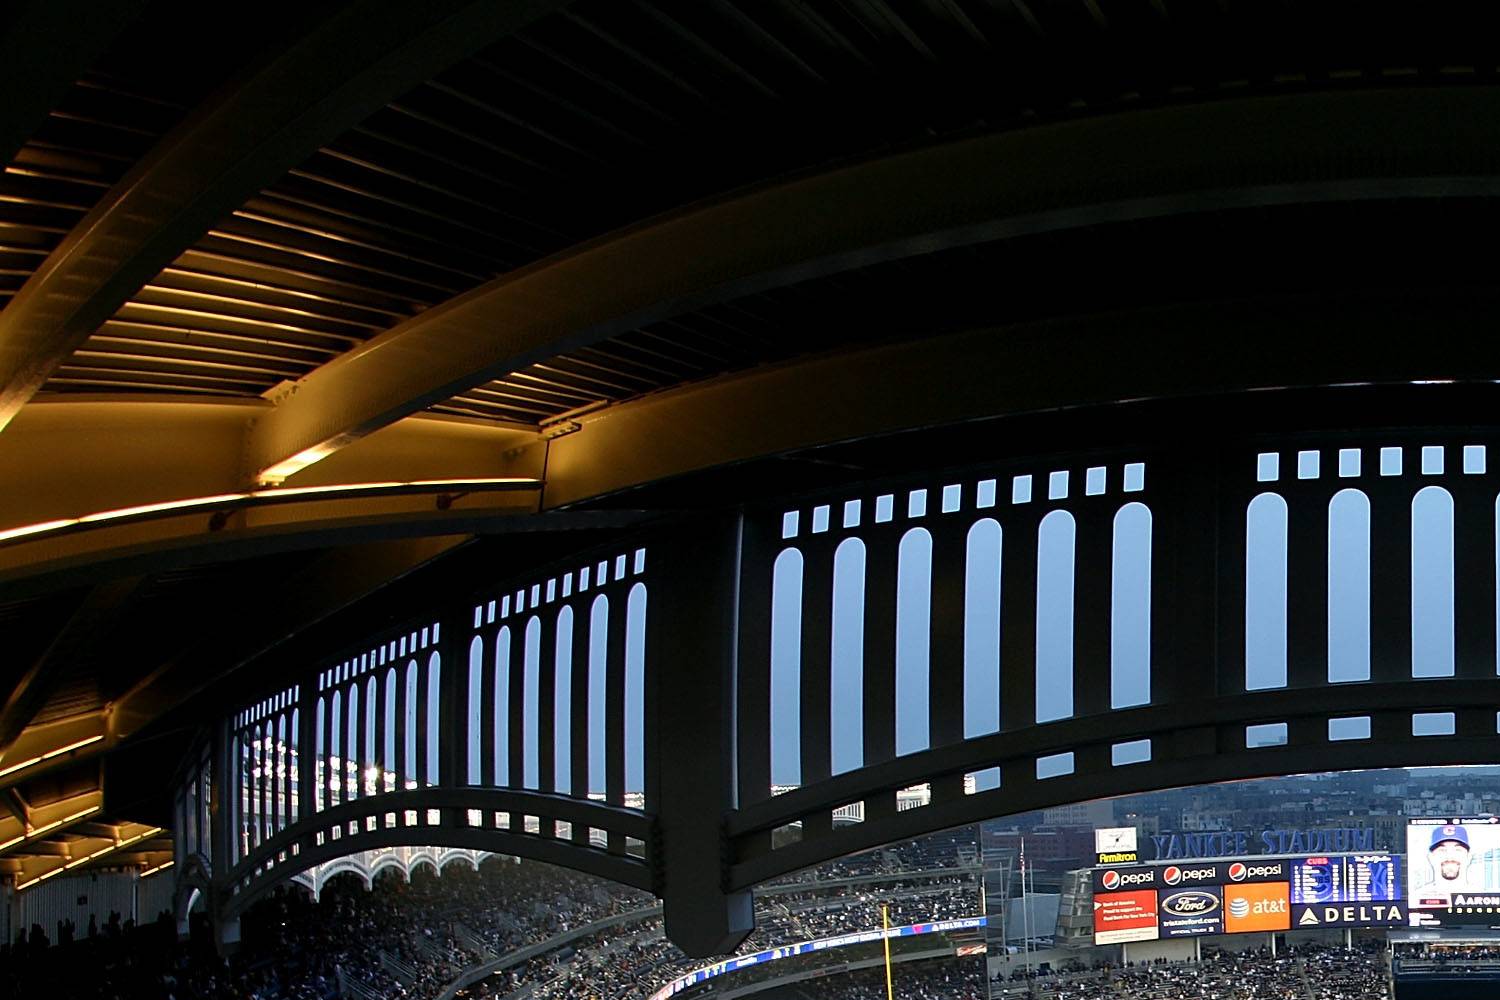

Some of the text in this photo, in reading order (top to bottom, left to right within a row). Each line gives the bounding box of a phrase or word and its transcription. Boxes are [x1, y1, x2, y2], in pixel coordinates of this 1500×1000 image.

[1151, 828, 1374, 860] YANKEE STADIUM
[1099, 853, 1137, 863] Armitron
[1120, 871, 1154, 886] pepsi
[1182, 867, 1216, 881] pepsi
[1247, 864, 1282, 878] pepsi
[1174, 896, 1206, 911] Ford
[1252, 897, 1286, 914] at&t
[1325, 905, 1402, 923] DELTA
